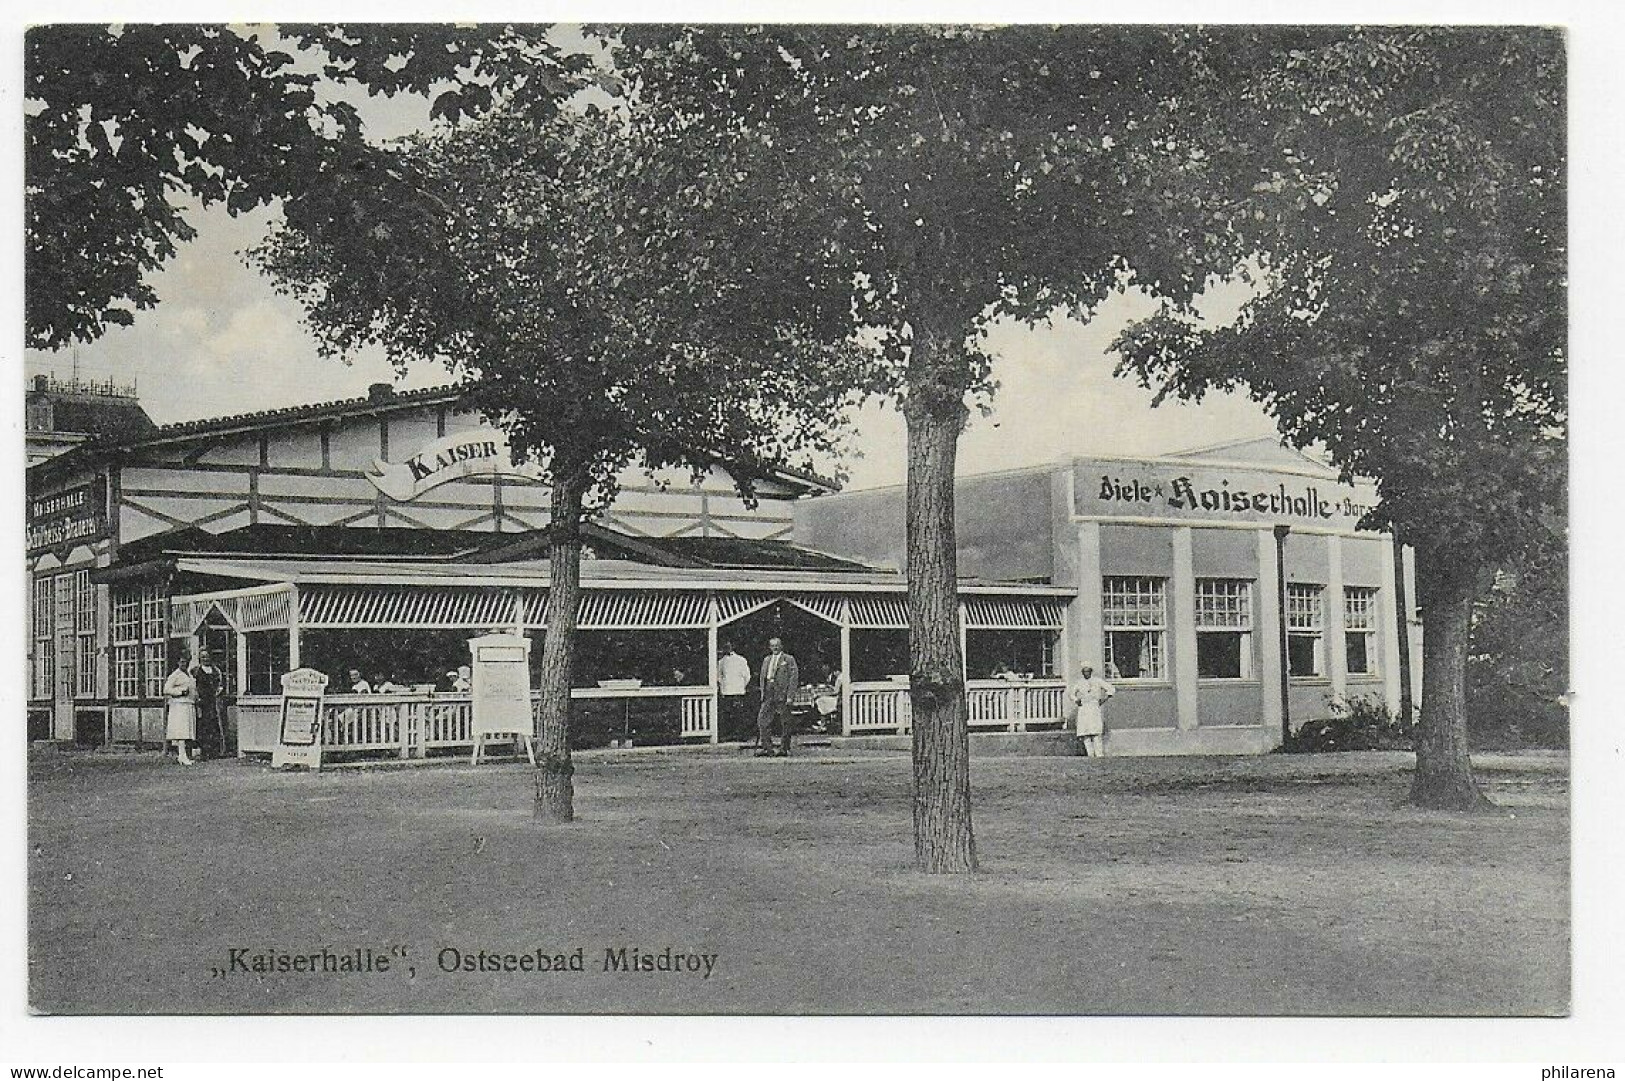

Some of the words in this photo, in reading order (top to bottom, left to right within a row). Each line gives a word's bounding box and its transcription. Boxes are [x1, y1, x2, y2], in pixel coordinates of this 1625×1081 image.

[404, 441, 498, 483] KAISER
[1099, 475, 1152, 503] Diele
[1167, 475, 1333, 519] Kaiserhalle
